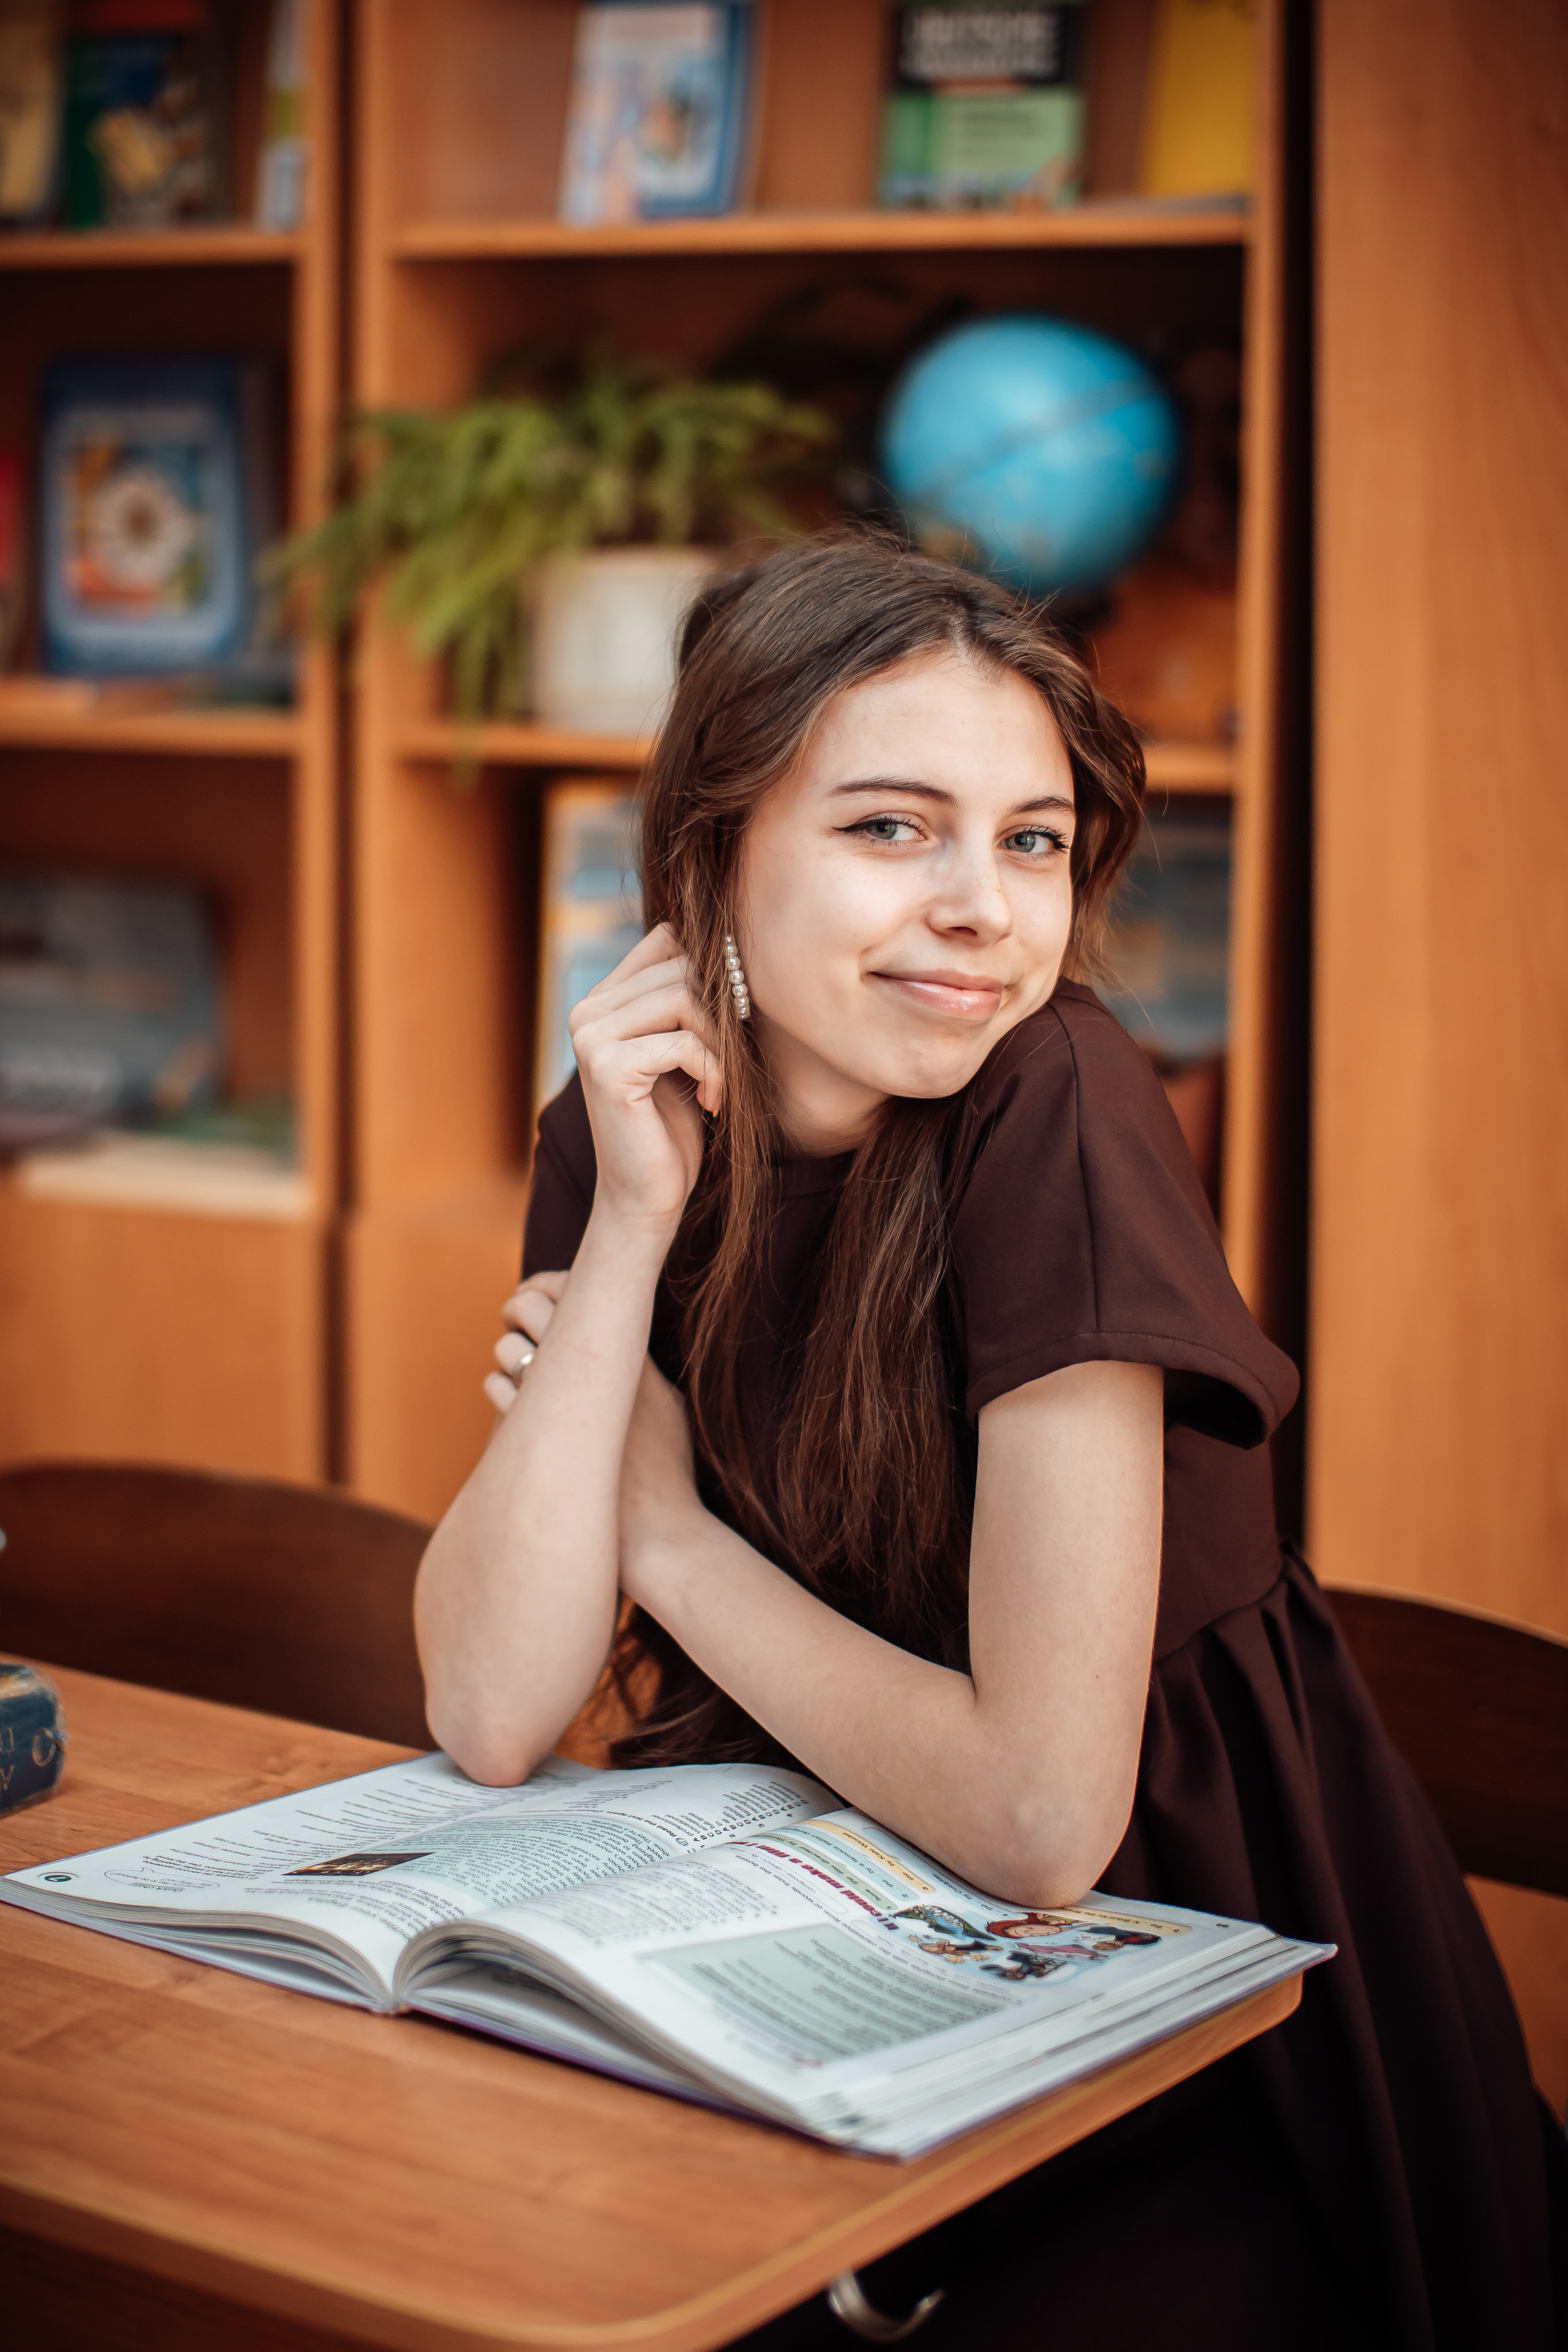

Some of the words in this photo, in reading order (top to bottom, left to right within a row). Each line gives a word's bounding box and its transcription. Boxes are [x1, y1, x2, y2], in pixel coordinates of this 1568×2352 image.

[722, 1811, 737, 1822] with
[723, 1806, 745, 1819] about
[650, 1814, 695, 1837] professional
[664, 1814, 700, 1834] vocational
[679, 1815, 709, 1831] amateur
[688, 1812, 716, 1830] full-time
[600, 1830, 629, 1844] between
[655, 1825, 678, 1838] Read
[607, 1837, 622, 1846] love
[624, 1833, 643, 1845] These
[538, 1845, 568, 1856] exported
[568, 1845, 601, 1861] successful
[601, 1840, 626, 1855] website
[631, 1843, 656, 1863] fighting
[869, 1848, 886, 1860] Kate
[519, 1853, 550, 1867] generally
[797, 1846, 831, 1864] directed
[833, 1846, 859, 1863] famous
[551, 1860, 571, 1872] things
[571, 1857, 587, 1868] been
[614, 1853, 635, 1870] What's
[626, 1855, 642, 1869] have
[514, 1868, 532, 1877] them
[534, 1871, 548, 1881] they
[541, 1869, 557, 1879] they
[549, 1866, 564, 1876] they
[573, 1866, 592, 1879] Factor
[800, 1864, 845, 1889] make
[902, 1871, 914, 1880] the
[452, 1877, 469, 1886] been
[772, 1874, 791, 1887] from
[786, 1872, 816, 1893] compose
[846, 1875, 859, 1885] the
[882, 1879, 894, 1888] the
[416, 1889, 440, 1899] writer
[472, 1887, 489, 1896] have
[495, 1883, 508, 1893] was
[744, 1885, 756, 1894] the
[408, 1897, 428, 1906] read
[410, 1893, 447, 1909] changed
[791, 1887, 814, 1903] words
[307, 1897, 349, 1907] English
[440, 1898, 453, 1907] the
[839, 1890, 883, 1917] could
[351, 1905, 377, 1918] your
[387, 1904, 413, 1918] shows
[392, 1901, 428, 1920] winners?
[823, 1909, 841, 1923] form
[878, 1947, 892, 1955] the
[892, 1954, 909, 1965] with
